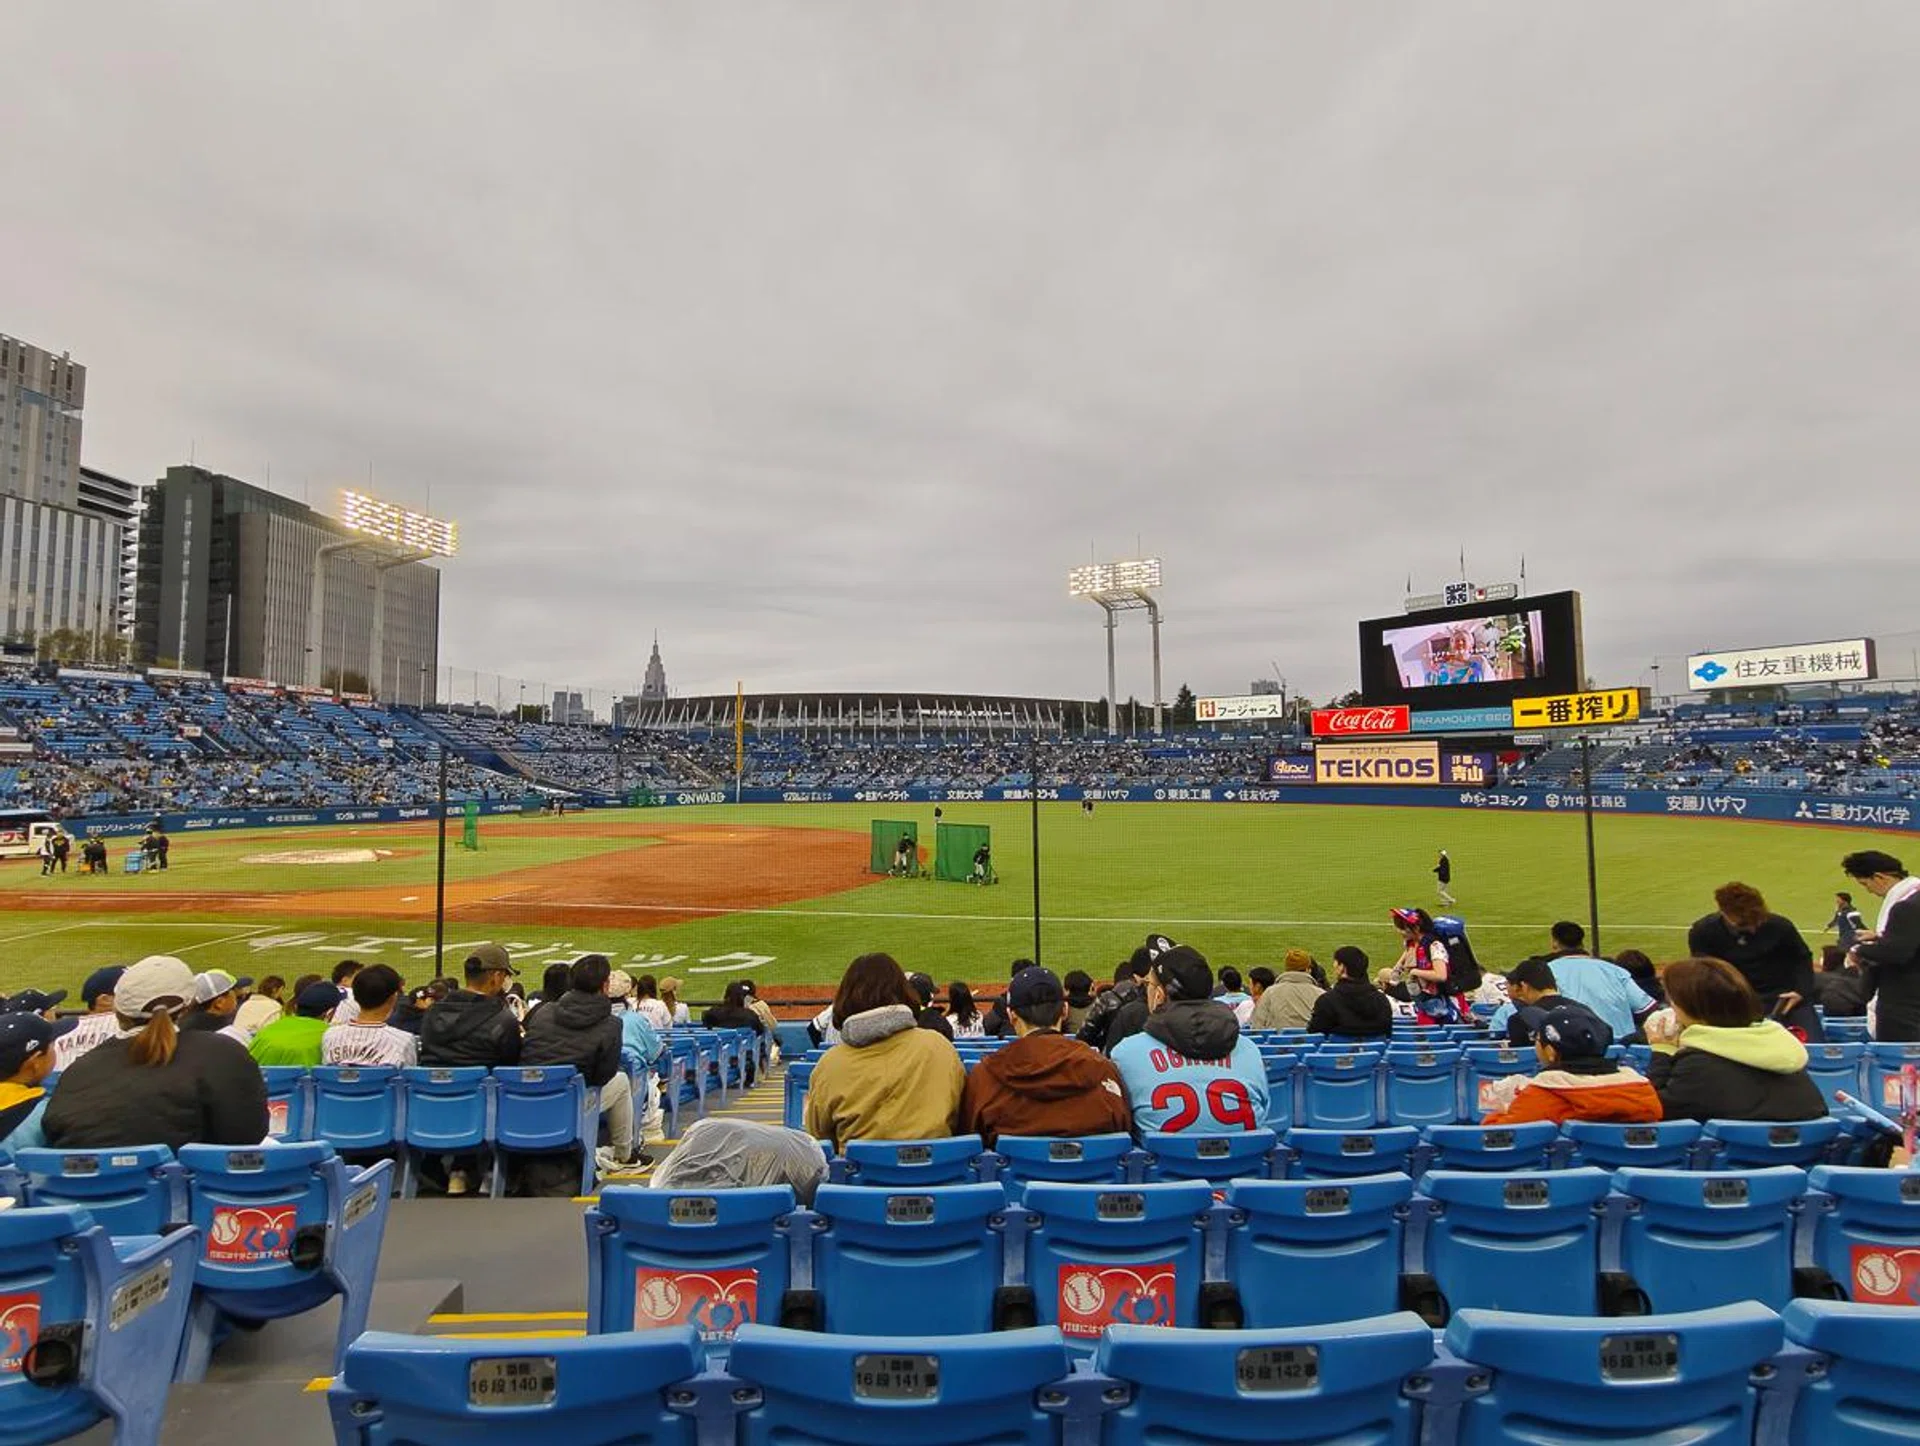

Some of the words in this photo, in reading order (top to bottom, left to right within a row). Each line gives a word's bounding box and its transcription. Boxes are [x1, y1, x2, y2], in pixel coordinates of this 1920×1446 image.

[1734, 651, 1862, 678] 住友重機械
[1217, 704, 1279, 717] フージャース
[1519, 693, 1630, 723] 一番搾り
[1329, 708, 1397, 730] Coca-Cola
[1412, 714, 1484, 726] PARAMOUNT
[1484, 713, 1512, 722] BED
[1320, 758, 1435, 778] TEKNOS
[1451, 764, 1483, 782] 青山
[680, 791, 724, 804] ONWARD
[1083, 789, 1130, 801] 安藤ハザマ
[1167, 788, 1212, 801] 東鉄工業
[1237, 789, 1281, 802] 住友化学
[1459, 791, 1528, 808] めちゃコミック
[1561, 794, 1627, 809] 竹中工務店
[1666, 795, 1747, 814] 安藤ハザマ
[1815, 802, 1910, 825] 三菱ガス化学
[1151, 1078, 1257, 1133] 29
